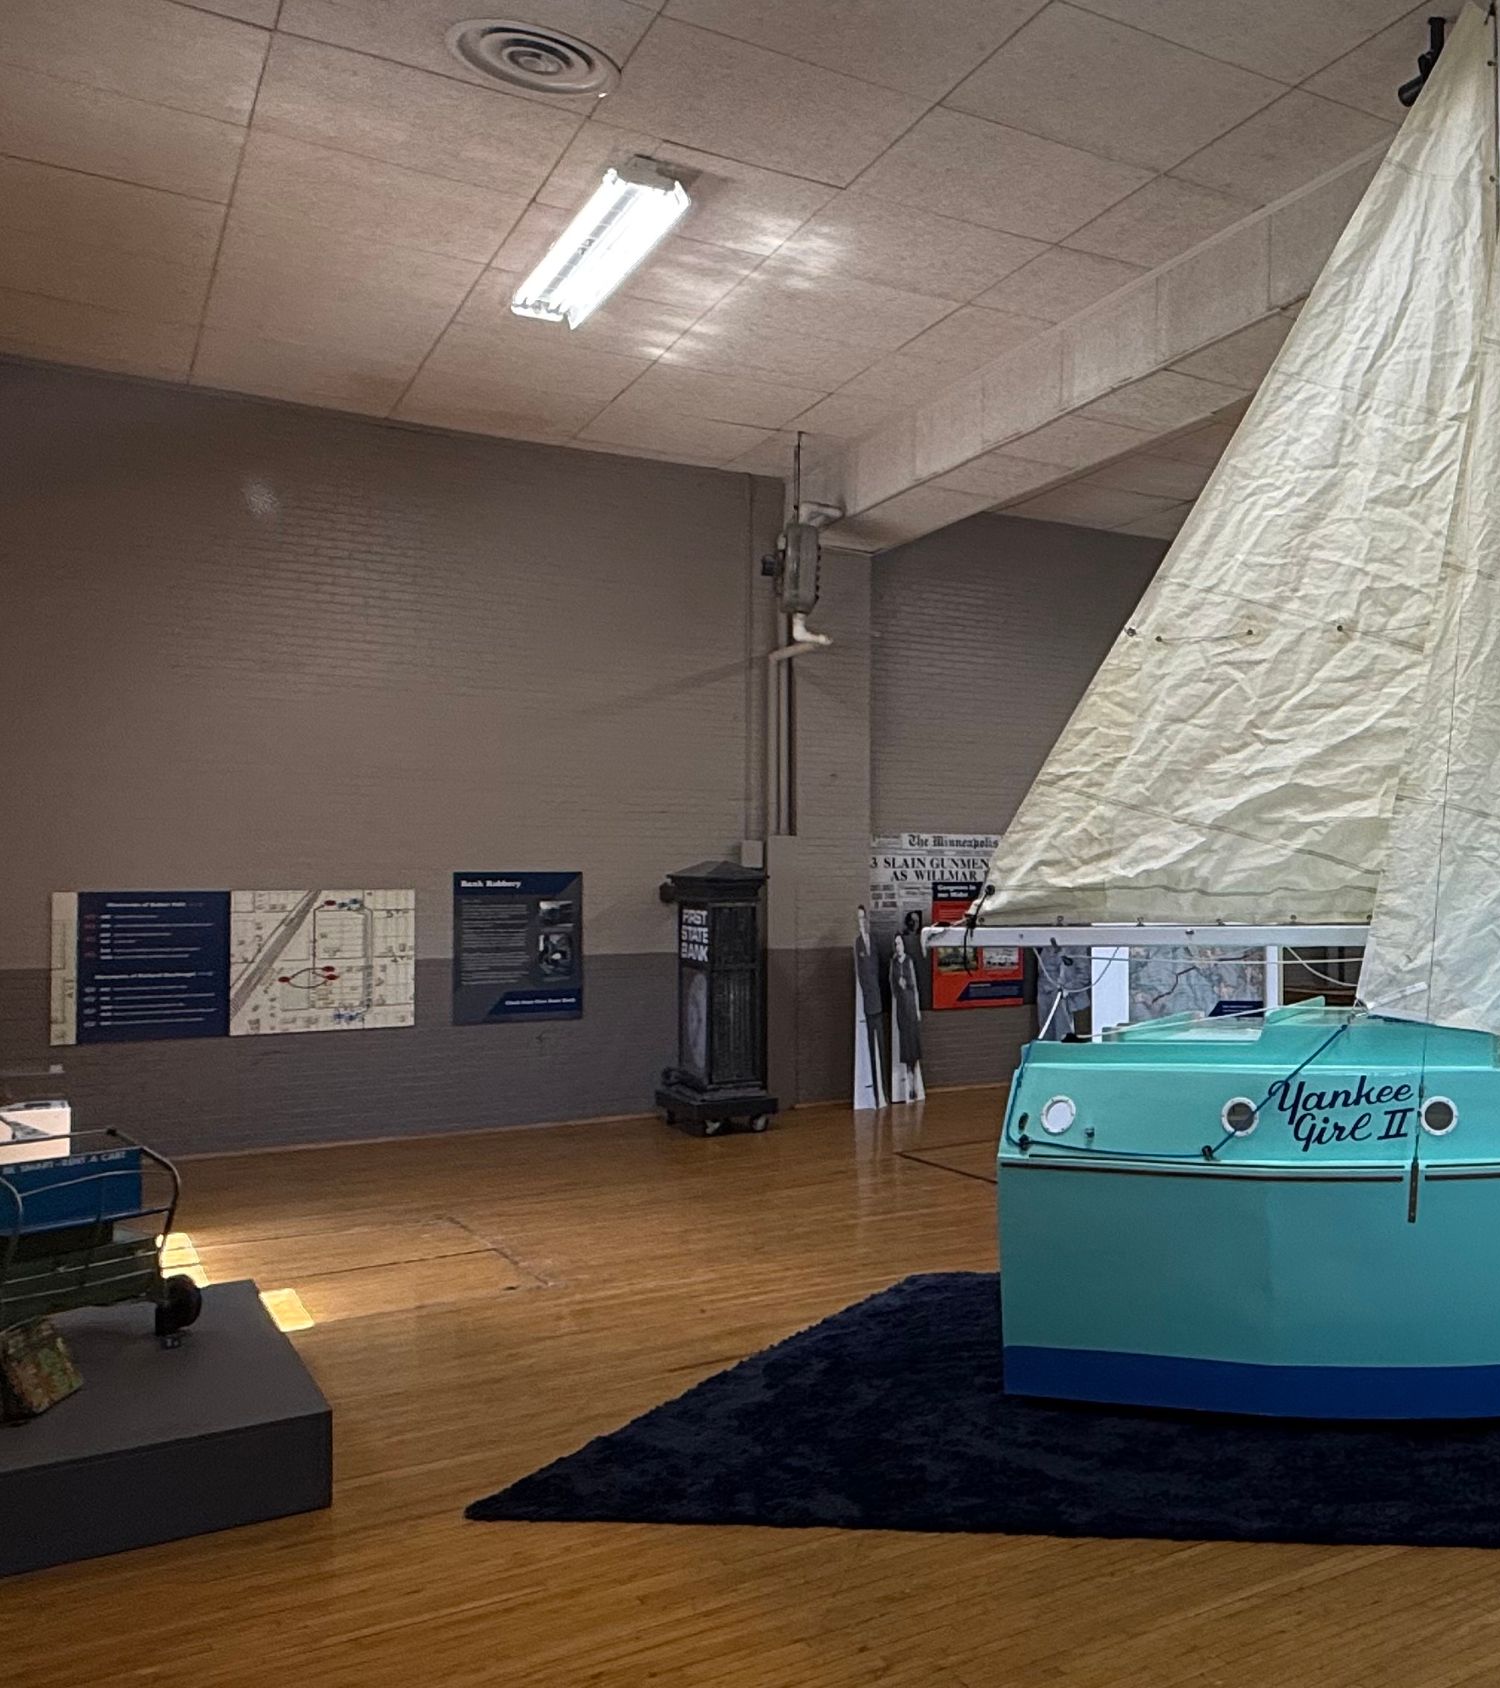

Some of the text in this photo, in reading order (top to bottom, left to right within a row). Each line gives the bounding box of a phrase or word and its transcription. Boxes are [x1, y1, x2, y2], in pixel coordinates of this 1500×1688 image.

[908, 834, 999, 849] The Minneapolis
[870, 857, 989, 869] 3 SLAIN GUNMEN
[891, 870, 908, 881] AS
[914, 870, 977, 881] WILLMAR
[486, 880, 521, 888] Robbery
[682, 909, 707, 925] FIRST
[681, 925, 708, 943] STATE
[681, 942, 708, 961] BANK
[1268, 1075, 1414, 1125] Yankee
[1293, 1107, 1415, 1152] Girl II
